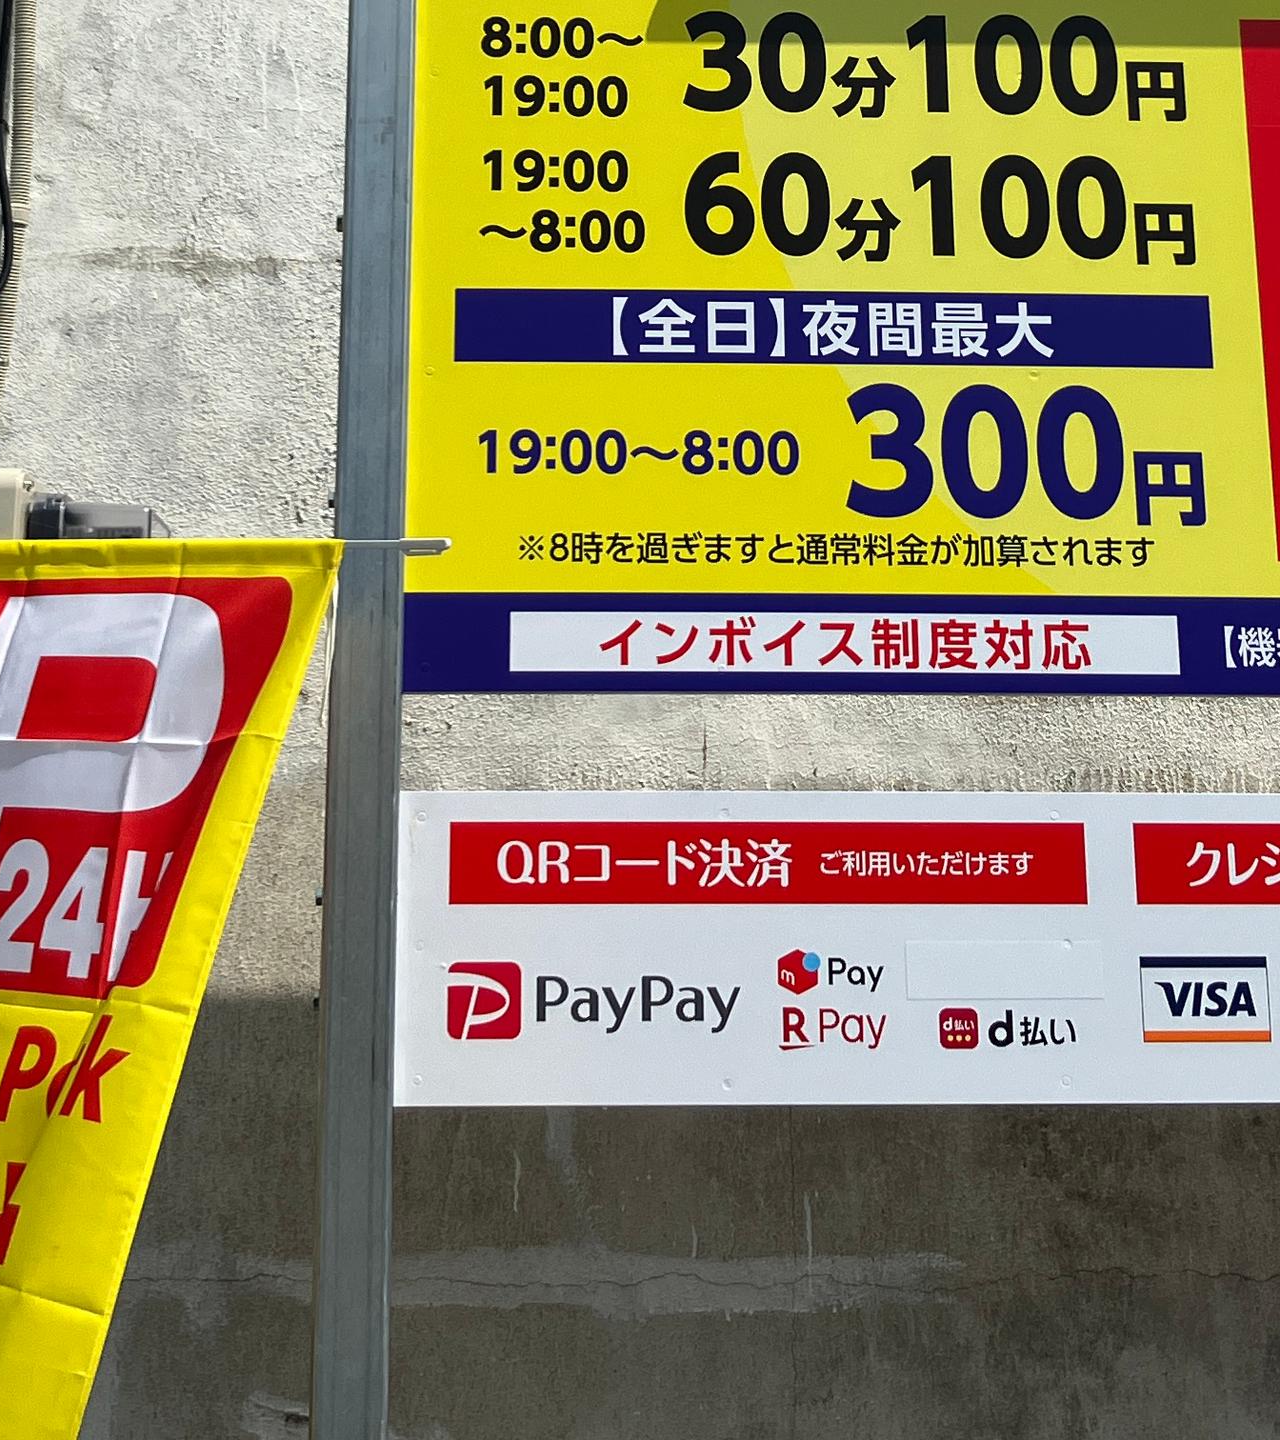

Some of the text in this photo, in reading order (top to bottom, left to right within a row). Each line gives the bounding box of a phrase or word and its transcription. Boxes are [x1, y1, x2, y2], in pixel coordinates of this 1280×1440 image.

[483, 75, 629, 119] 19:00
[483, 150, 629, 193] 19:00
[611, 298, 1054, 361] 【全日】夜間最大
[845, 384, 1206, 527] 300円
[518, 530, 1156, 569] ※8時を過ぎますと通常料金が加算されます
[599, 617, 1092, 671] インボイス制度対応
[496, 839, 1034, 889] QRコード決済 ご利用いただけます
[828, 957, 885, 993] Pay
[535, 975, 741, 1033] PayPay
[1154, 980, 1257, 1018] VISA
[819, 1008, 887, 1049] Pay
[988, 1009, 1077, 1048] d払い
